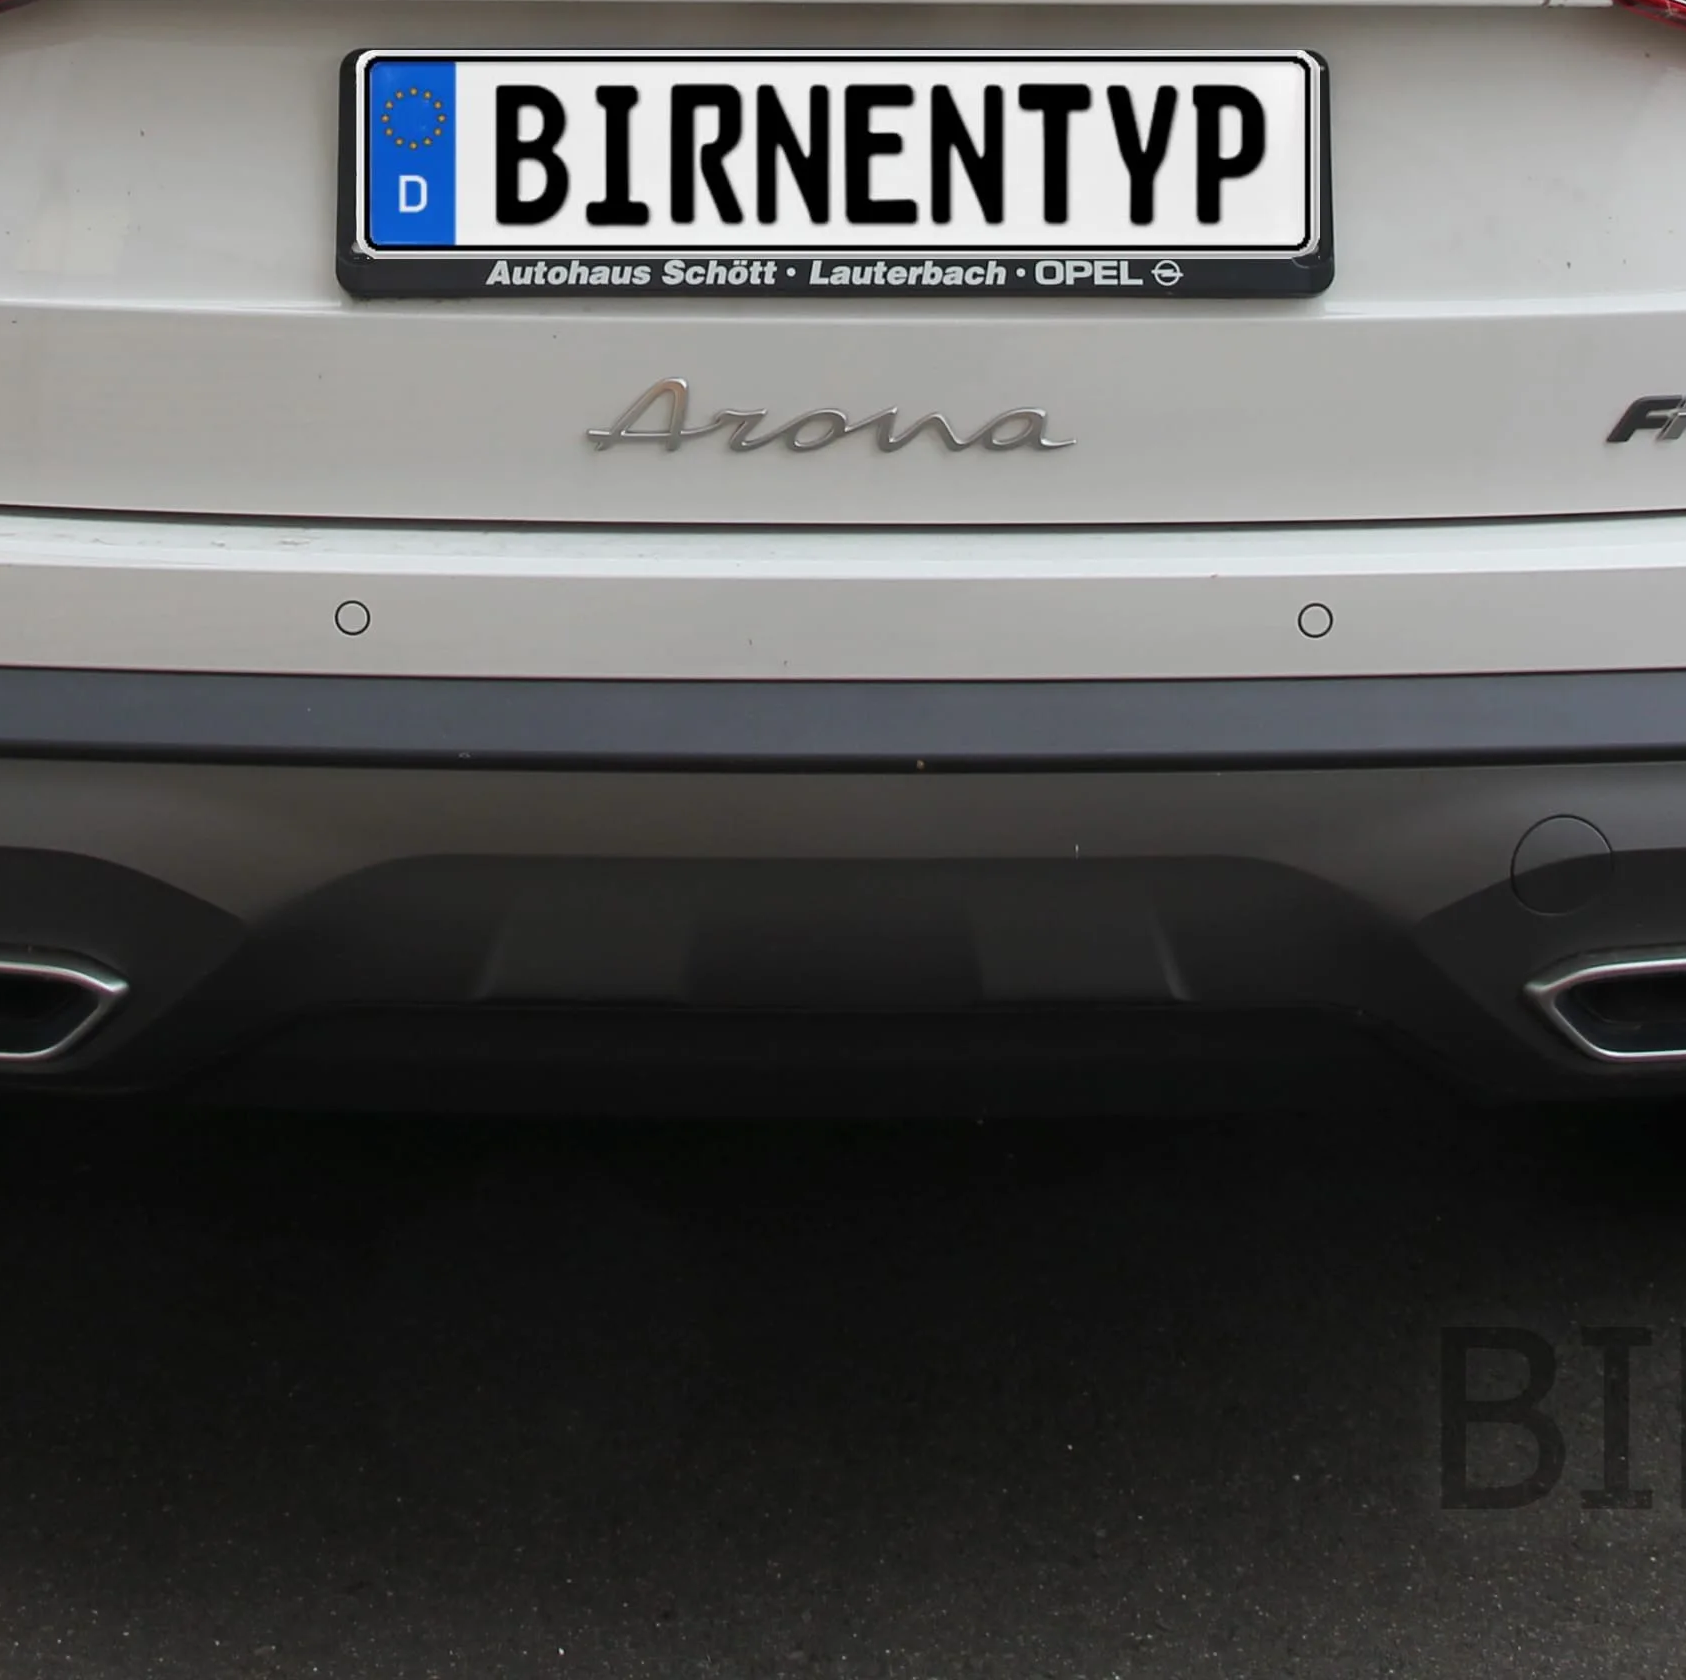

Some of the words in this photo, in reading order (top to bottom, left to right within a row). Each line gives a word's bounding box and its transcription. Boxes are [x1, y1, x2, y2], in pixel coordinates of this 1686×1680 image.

[493, 83, 1268, 226] BIRNENTYP
[398, 174, 428, 214] D
[486, 259, 652, 286] Autohaus
[661, 259, 778, 286] Schött
[809, 259, 1007, 286] Lauterbach
[1034, 259, 1144, 286] OPEL
[586, 375, 1077, 453] Arona
